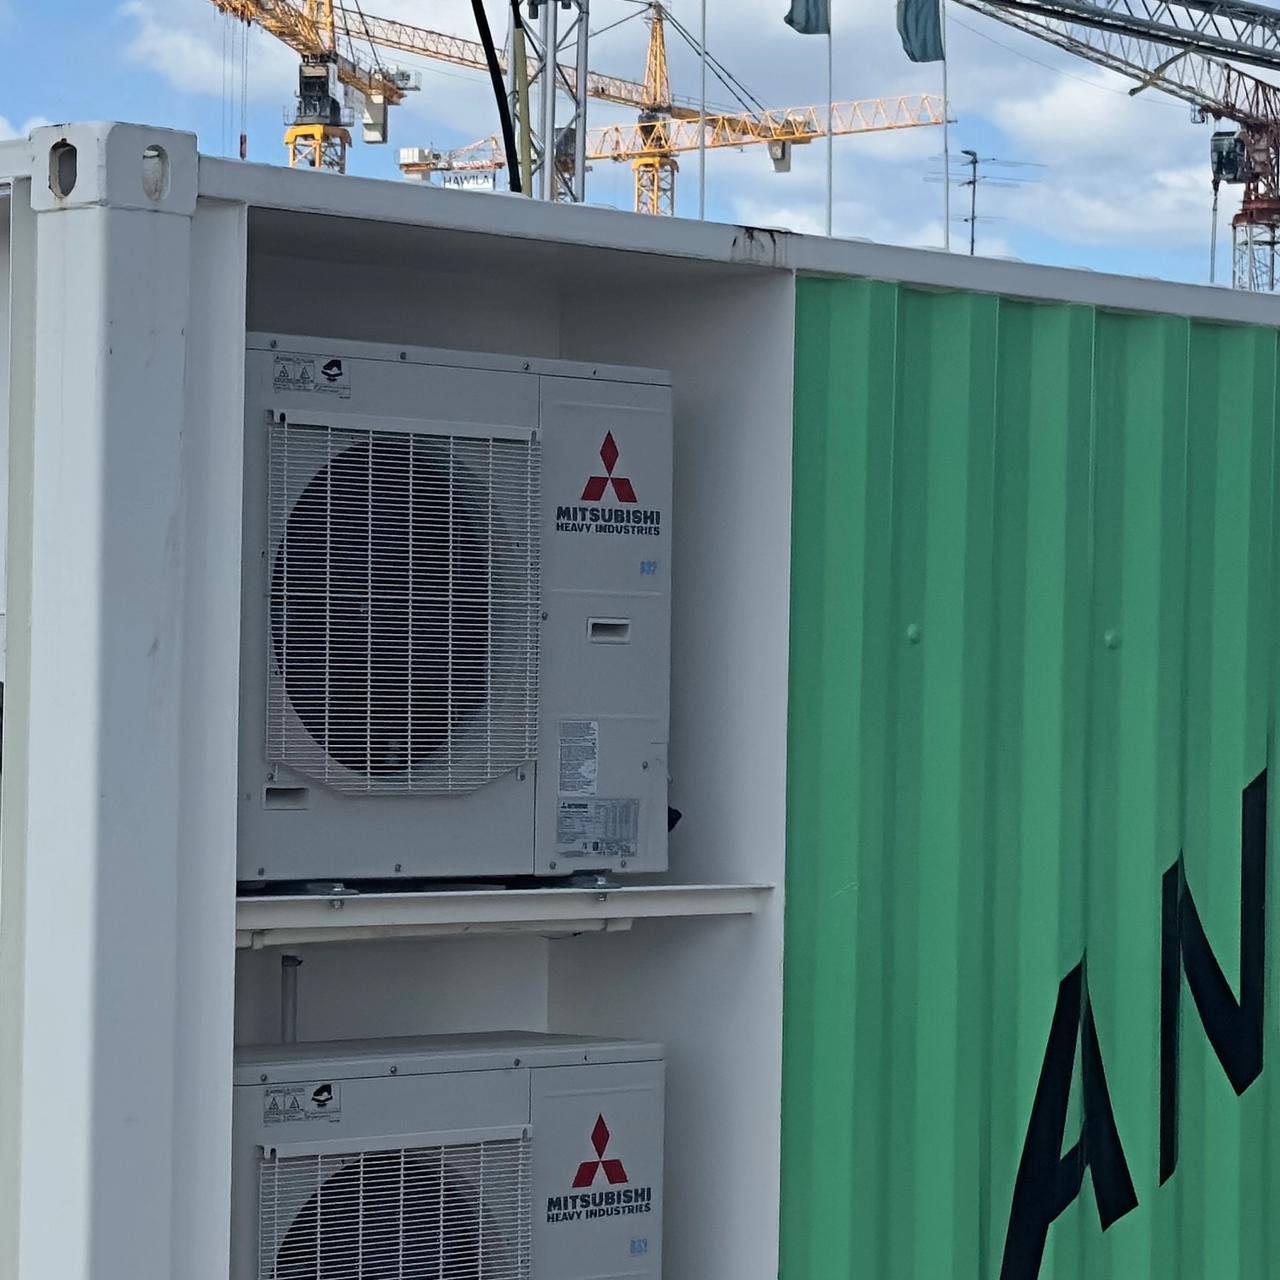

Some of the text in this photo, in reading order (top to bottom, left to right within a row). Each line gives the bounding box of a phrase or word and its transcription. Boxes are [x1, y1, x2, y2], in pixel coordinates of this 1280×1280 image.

[556, 506, 661, 525] MITSUBISHI
[556, 523, 660, 536] HEAVY INDUSTRIES
[547, 1187, 651, 1212] MITSUBISHI
[547, 1203, 651, 1222] HEAVY INDUSTRIES
